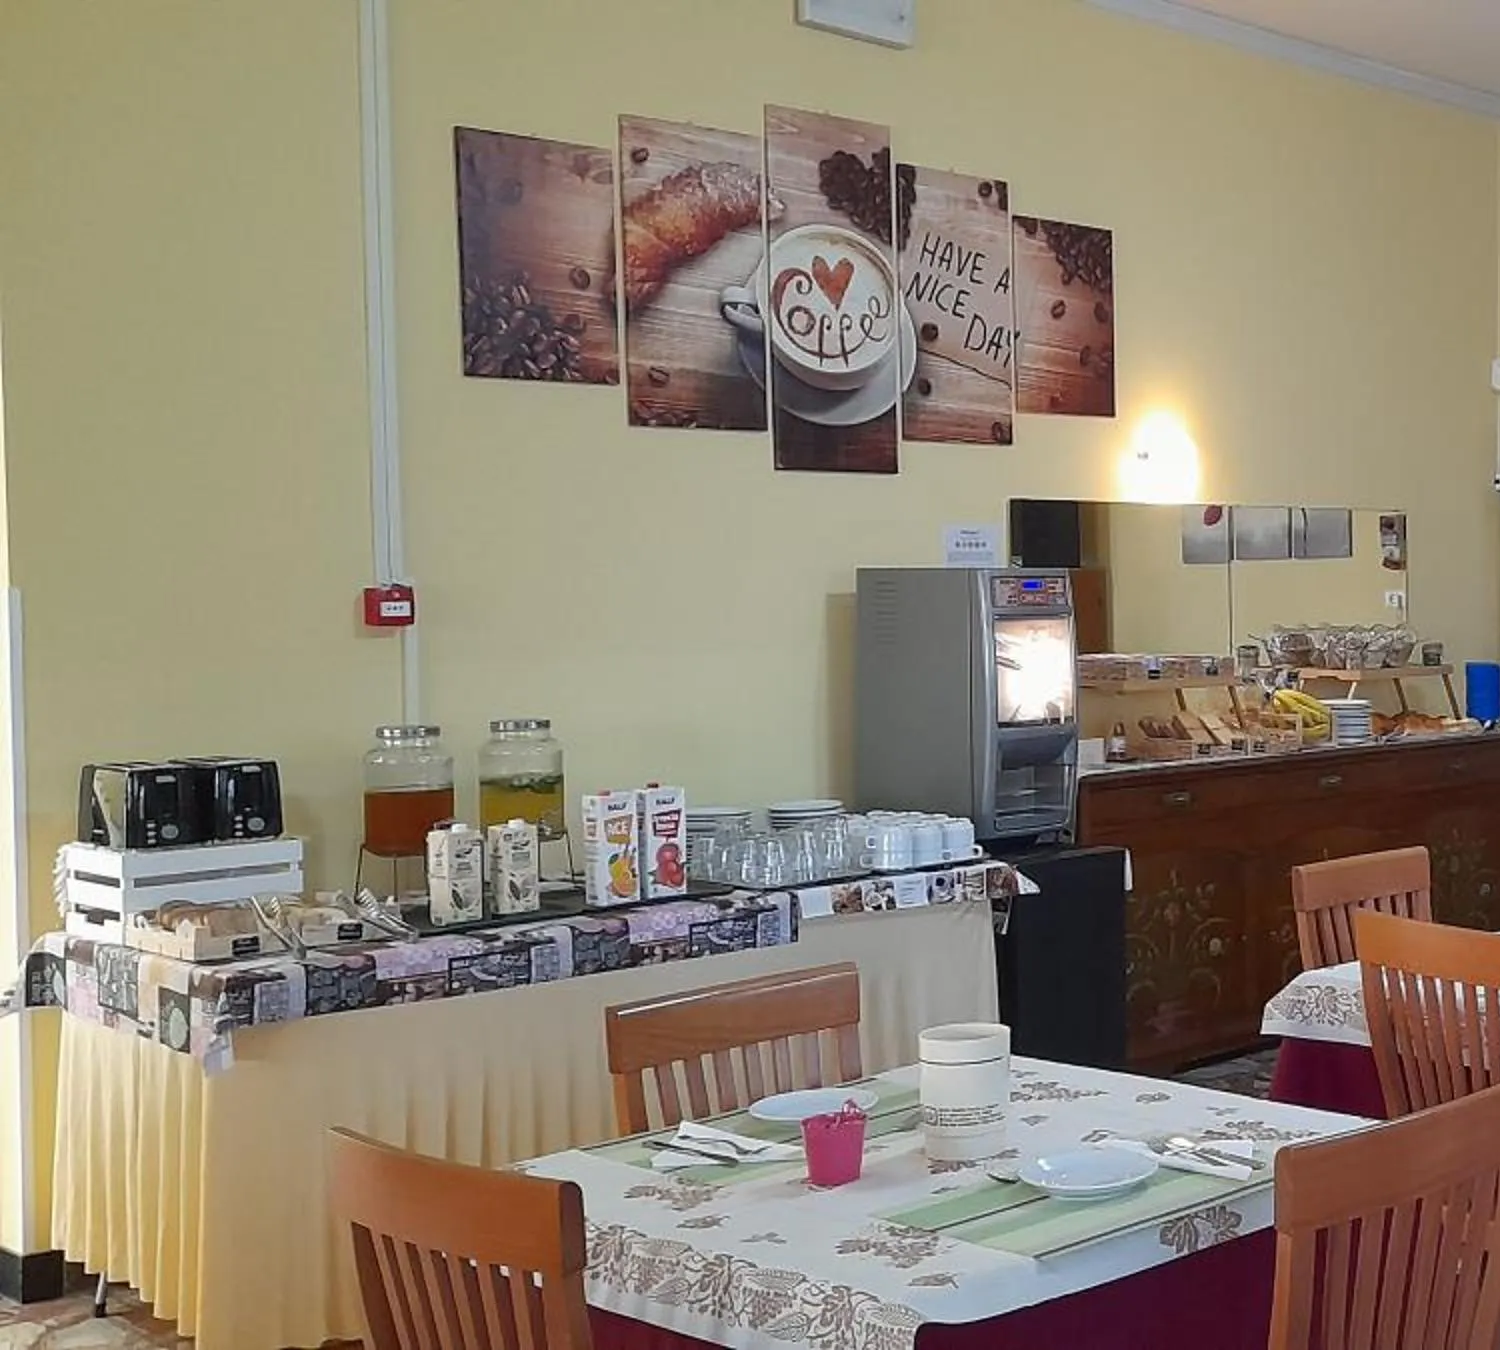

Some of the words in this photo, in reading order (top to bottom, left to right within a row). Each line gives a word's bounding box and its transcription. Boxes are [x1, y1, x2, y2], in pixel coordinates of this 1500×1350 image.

[918, 232, 987, 285] HAVE
[992, 266, 1011, 295] A
[905, 271, 971, 319] NICE
[963, 314, 1021, 369] DAY
